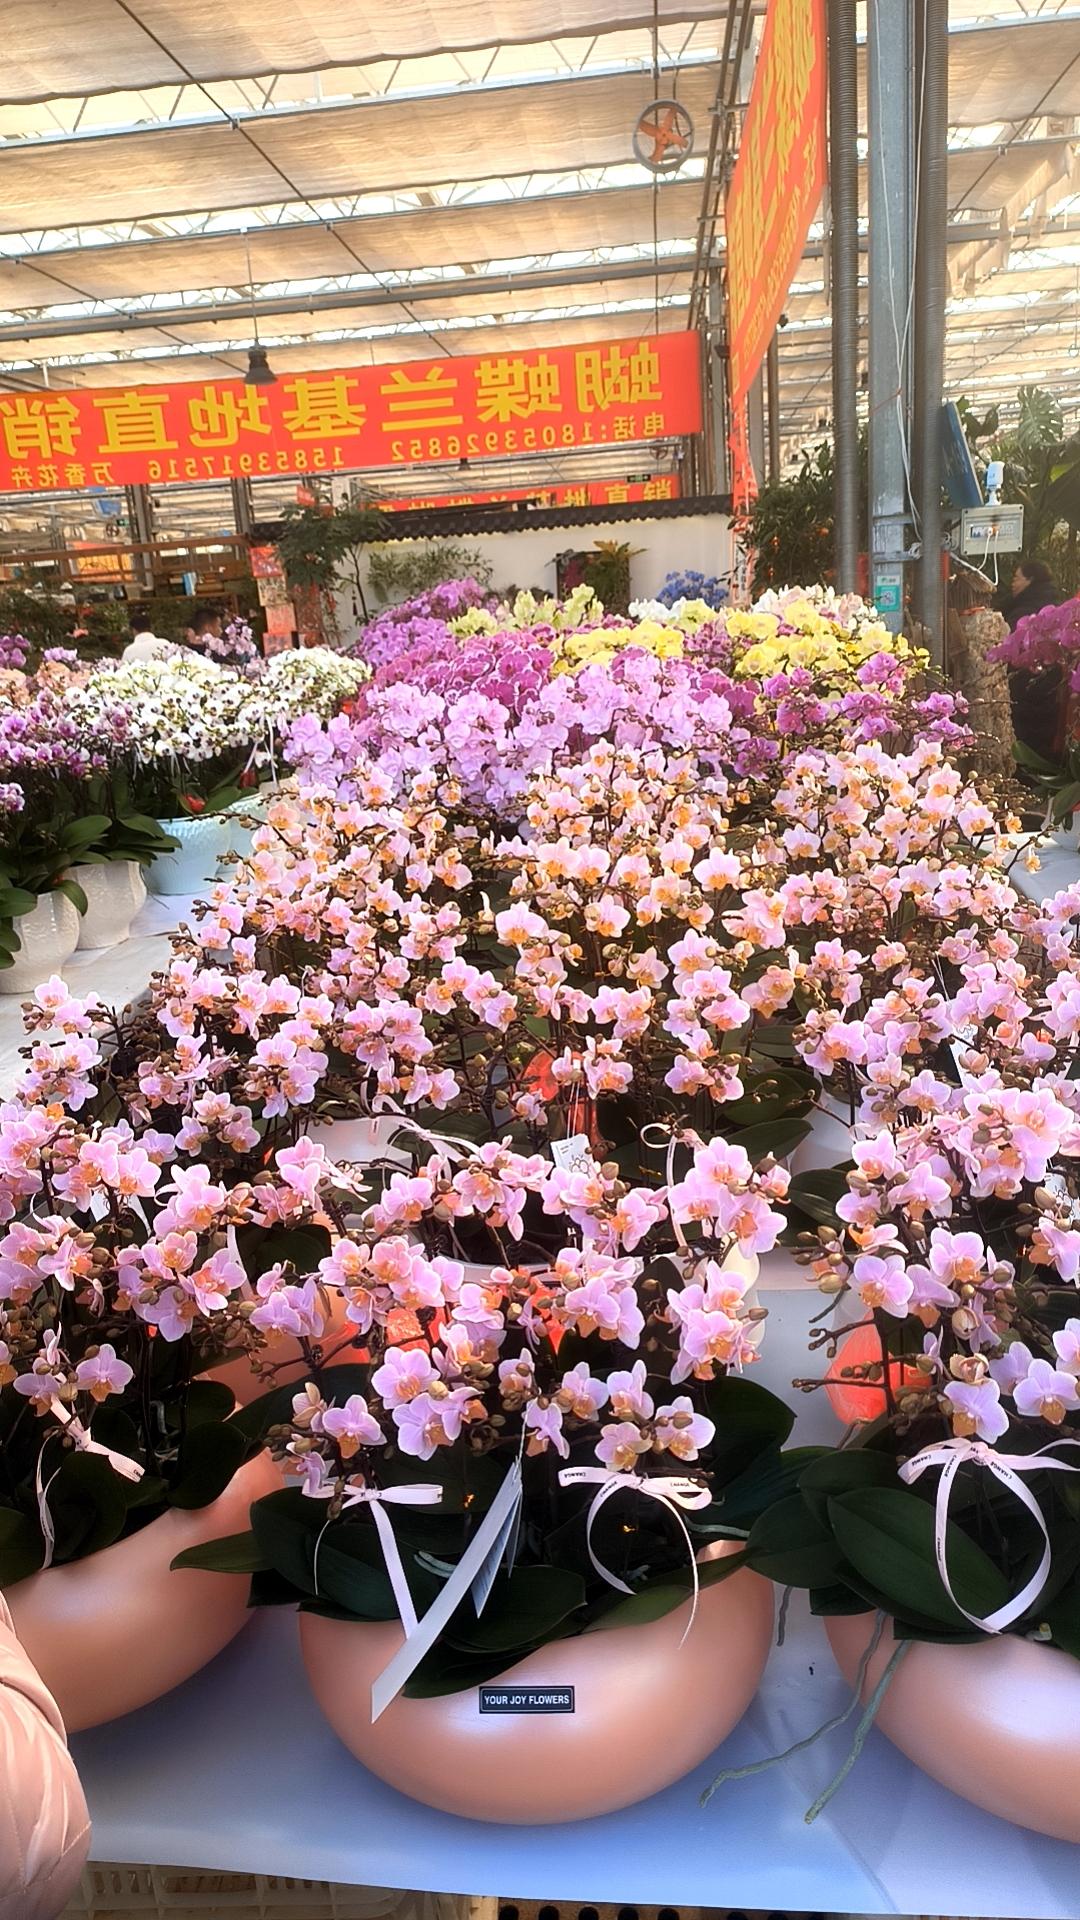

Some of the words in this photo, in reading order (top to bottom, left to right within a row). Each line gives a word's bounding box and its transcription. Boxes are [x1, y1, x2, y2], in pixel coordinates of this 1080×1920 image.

[484, 1695, 507, 1704] YOUR
[510, 1695, 527, 1704] JOY
[529, 1695, 569, 1704] FLOWERS
